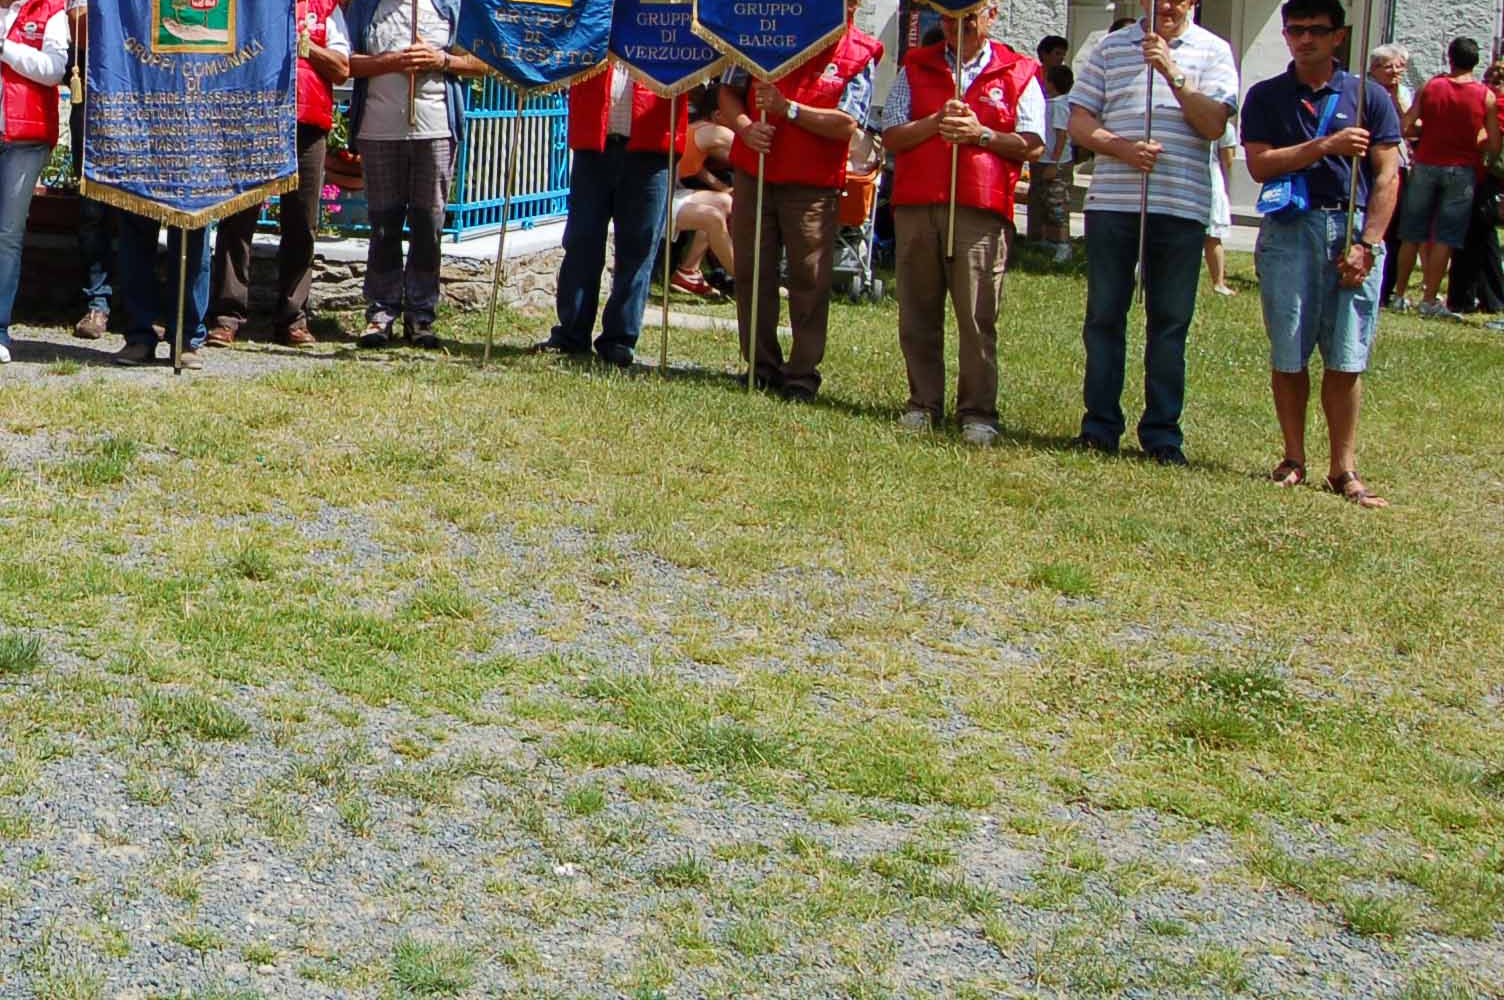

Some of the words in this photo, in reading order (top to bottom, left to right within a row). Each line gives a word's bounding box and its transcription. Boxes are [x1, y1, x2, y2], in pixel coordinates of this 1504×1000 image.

[734, 2, 803, 17] GRUPPO
[495, 7, 576, 28] GRUPPO
[759, 18, 777, 33] DI
[661, 29, 677, 43] DI
[738, 33, 797, 48] BARGE
[123, 36, 176, 75] GRUPPI
[182, 38, 265, 78] COMUNALI
[471, 39, 596, 65] FALICETTO
[624, 44, 715, 61] VERZUOLO
[185, 76, 201, 91] DI
